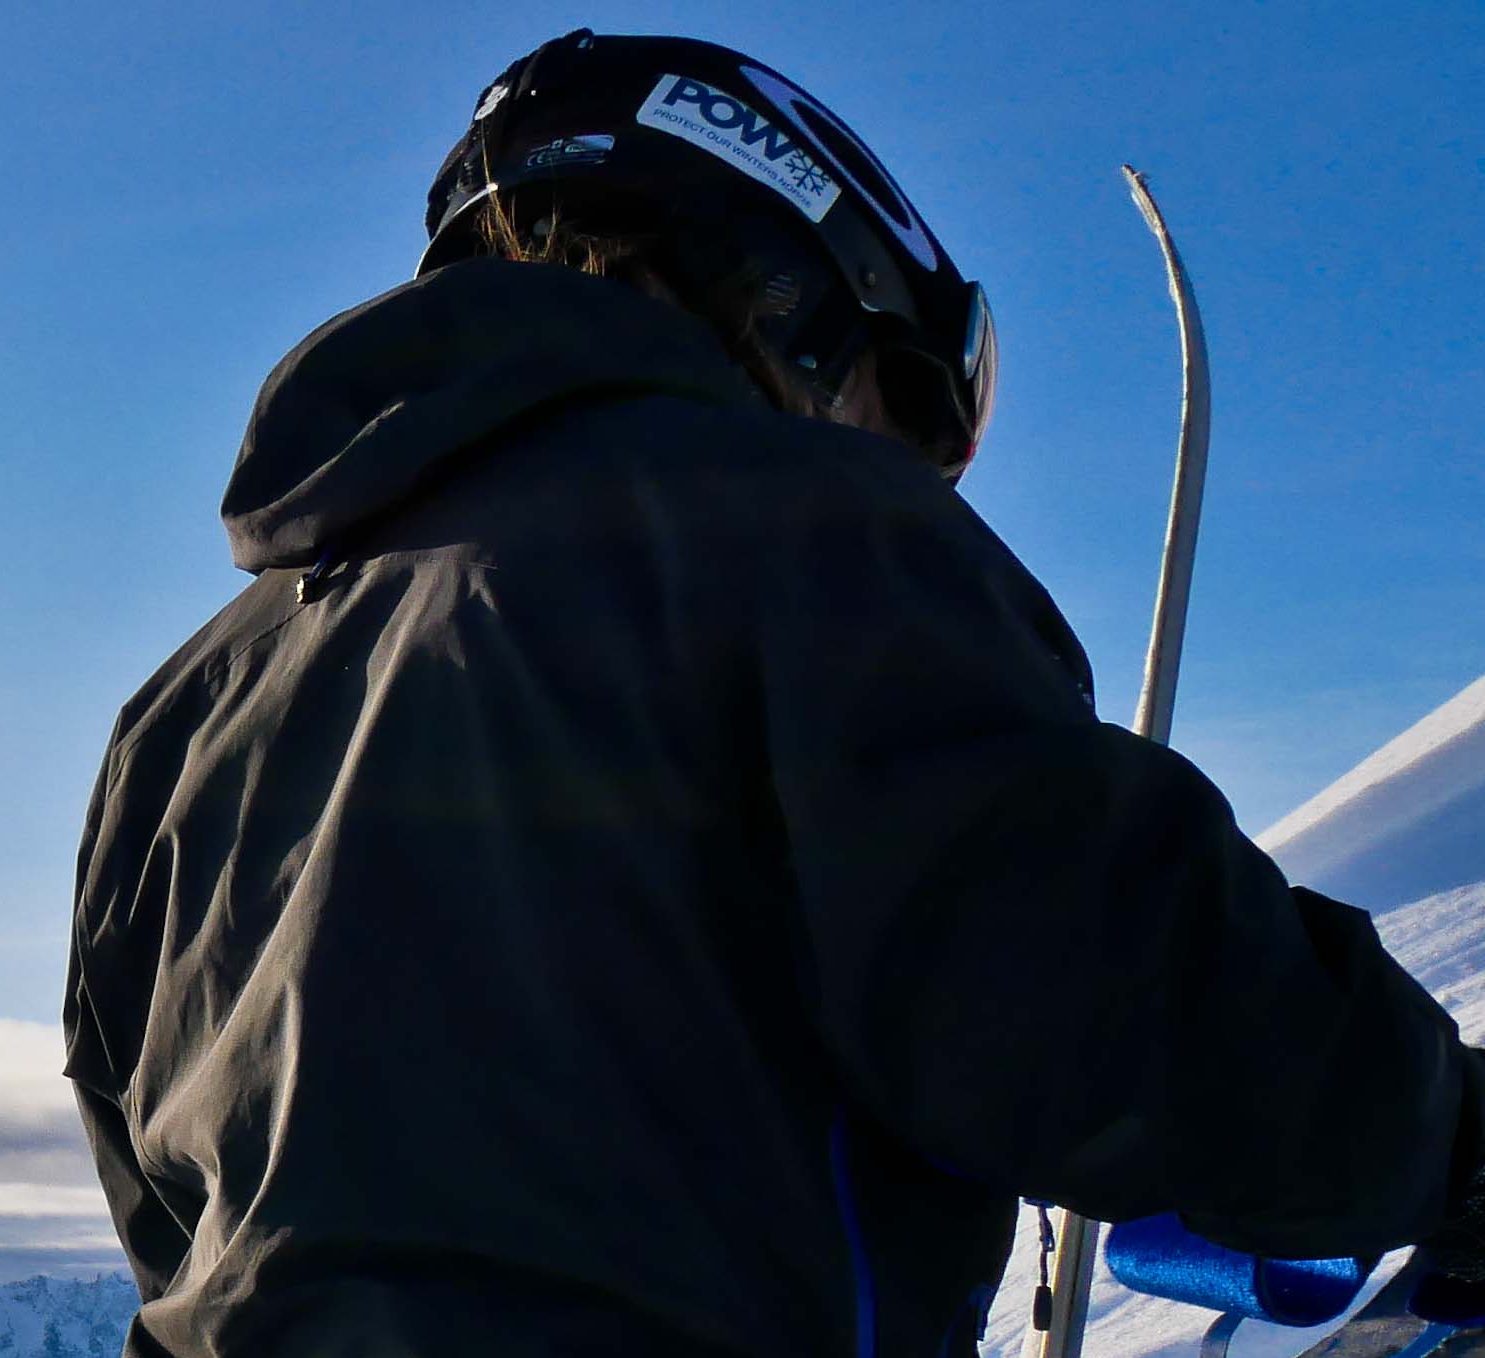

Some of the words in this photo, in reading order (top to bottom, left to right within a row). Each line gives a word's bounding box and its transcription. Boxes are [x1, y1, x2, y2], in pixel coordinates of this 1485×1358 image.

[653, 109, 705, 134] PROTECT
[707, 131, 732, 152] OUR
[732, 145, 778, 180] WINTERS
[662, 77, 799, 161] POW
